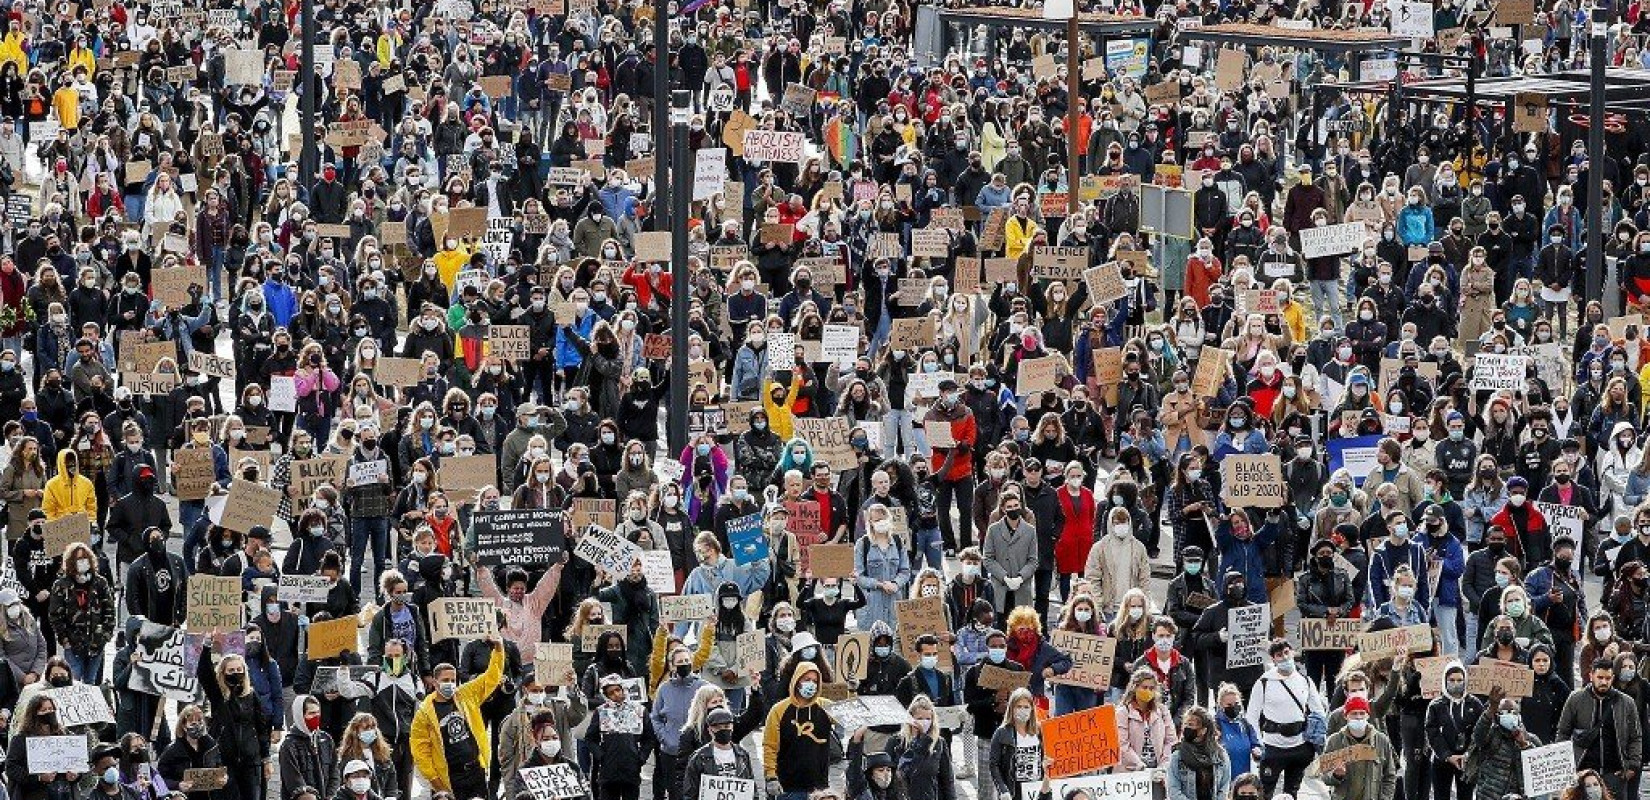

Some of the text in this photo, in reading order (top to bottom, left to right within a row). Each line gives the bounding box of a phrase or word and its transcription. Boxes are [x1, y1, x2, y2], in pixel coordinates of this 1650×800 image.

[745, 133, 801, 148] ABOLISH
[1036, 247, 1086, 257] SILENCE
[1034, 266, 1084, 279] BETRAYA
[491, 328, 529, 339] BLACK
[492, 340, 529, 350] LIVES
[489, 350, 529, 359] MATTER
[190, 353, 233, 377] NO PEACE
[130, 381, 173, 394] JUSTICE
[800, 418, 848, 431] JUSTICE
[810, 431, 850, 447] PEACE
[299, 460, 336, 477] BLACK
[1235, 462, 1269, 472] BLACK
[1236, 472, 1274, 483] GENOCIDE
[190, 578, 235, 593] WHITE
[190, 591, 239, 607] SILENCE
[445, 601, 493, 614] BEAUTY
[450, 614, 470, 622] WAS
[1301, 621, 1323, 648] NO
[1053, 637, 1103, 653] WHITE
[1058, 713, 1103, 738] FUCK
[1053, 732, 1108, 758] ETNISCH
[529, 776, 568, 791] LIVES
[708, 778, 749, 793] RUTTE
